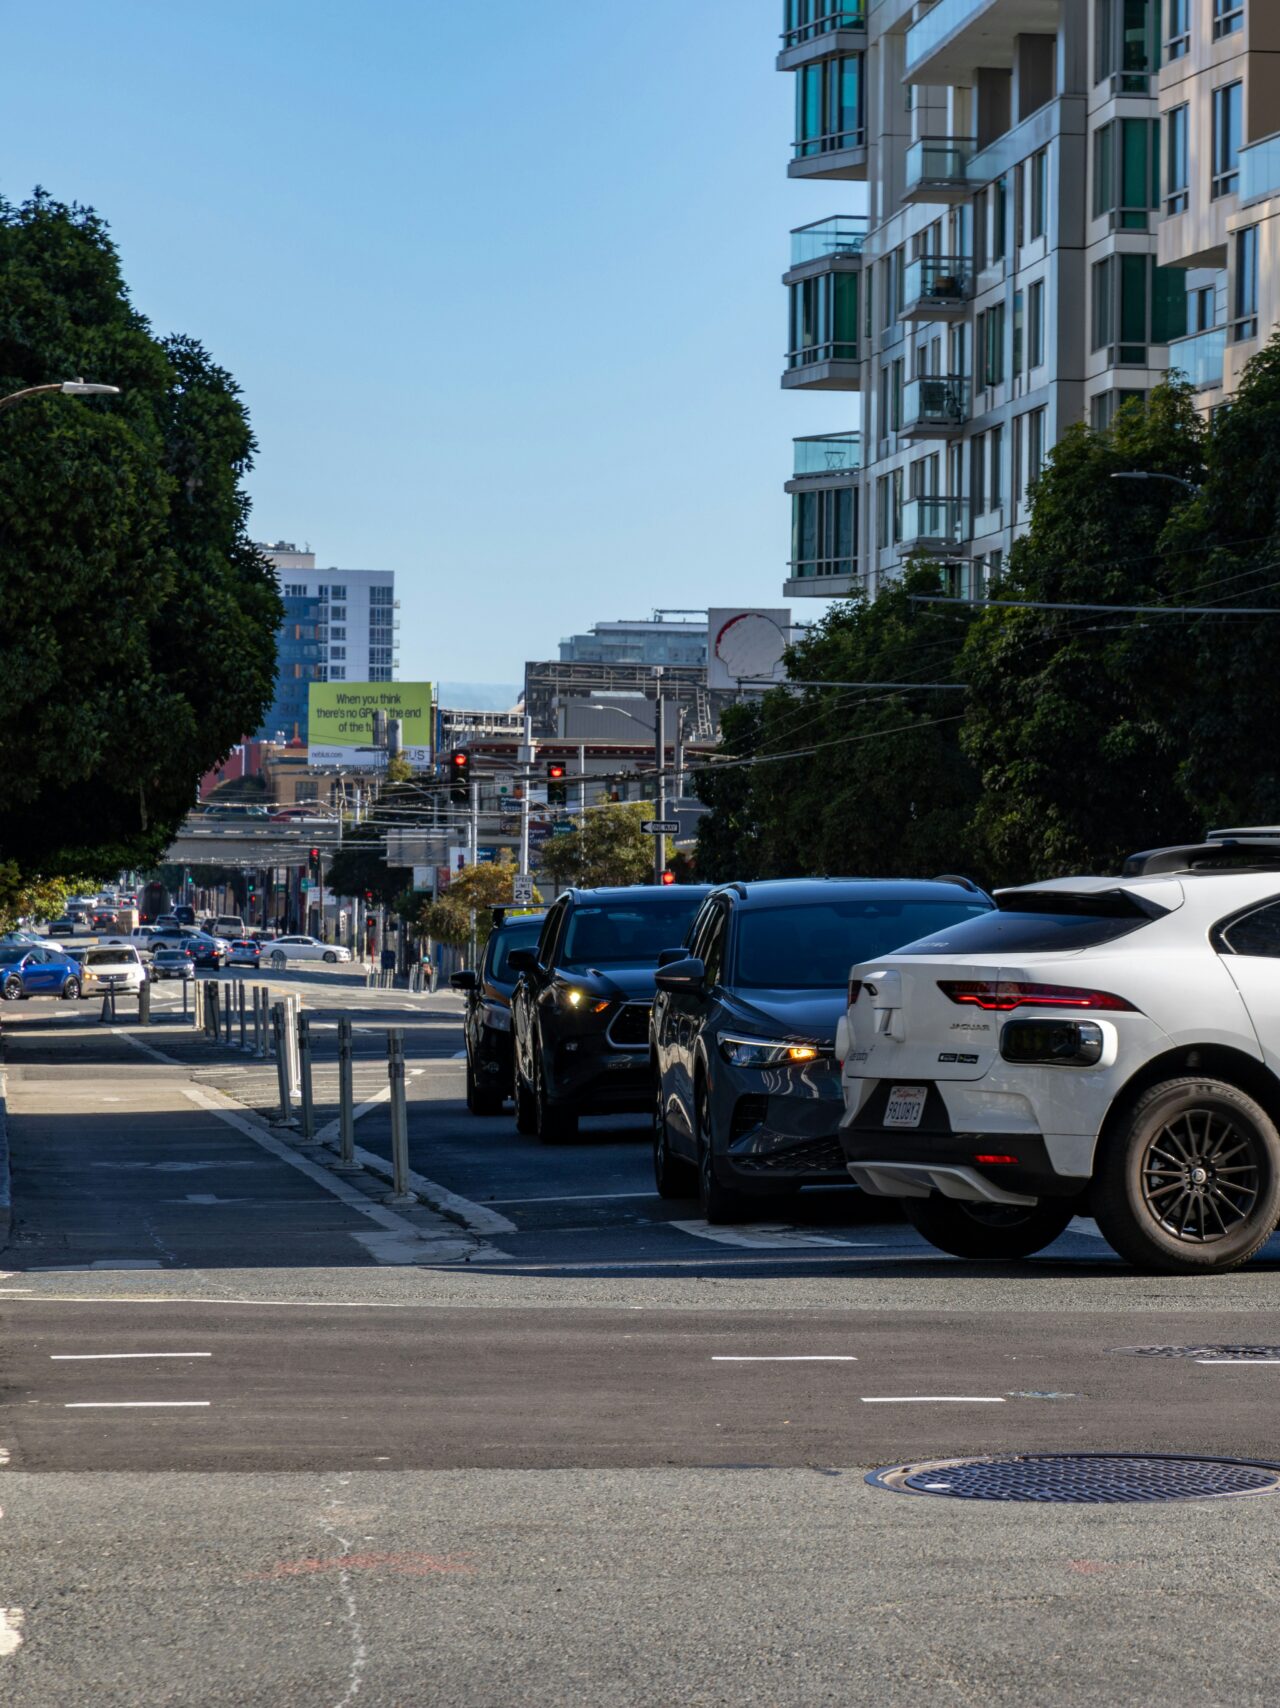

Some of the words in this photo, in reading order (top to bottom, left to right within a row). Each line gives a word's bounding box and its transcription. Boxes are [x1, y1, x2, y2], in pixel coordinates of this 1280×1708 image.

[336, 693, 361, 704] When
[362, 695, 378, 706] you
[380, 693, 401, 704] think
[317, 708, 346, 718] there's
[346, 710, 357, 718] no
[390, 708, 404, 718] the
[405, 708, 421, 718] end
[338, 722, 348, 732] of
[349, 722, 364, 732] the
[515, 890, 531, 899] 25
[949, 1023, 990, 1031] JAGUAR
